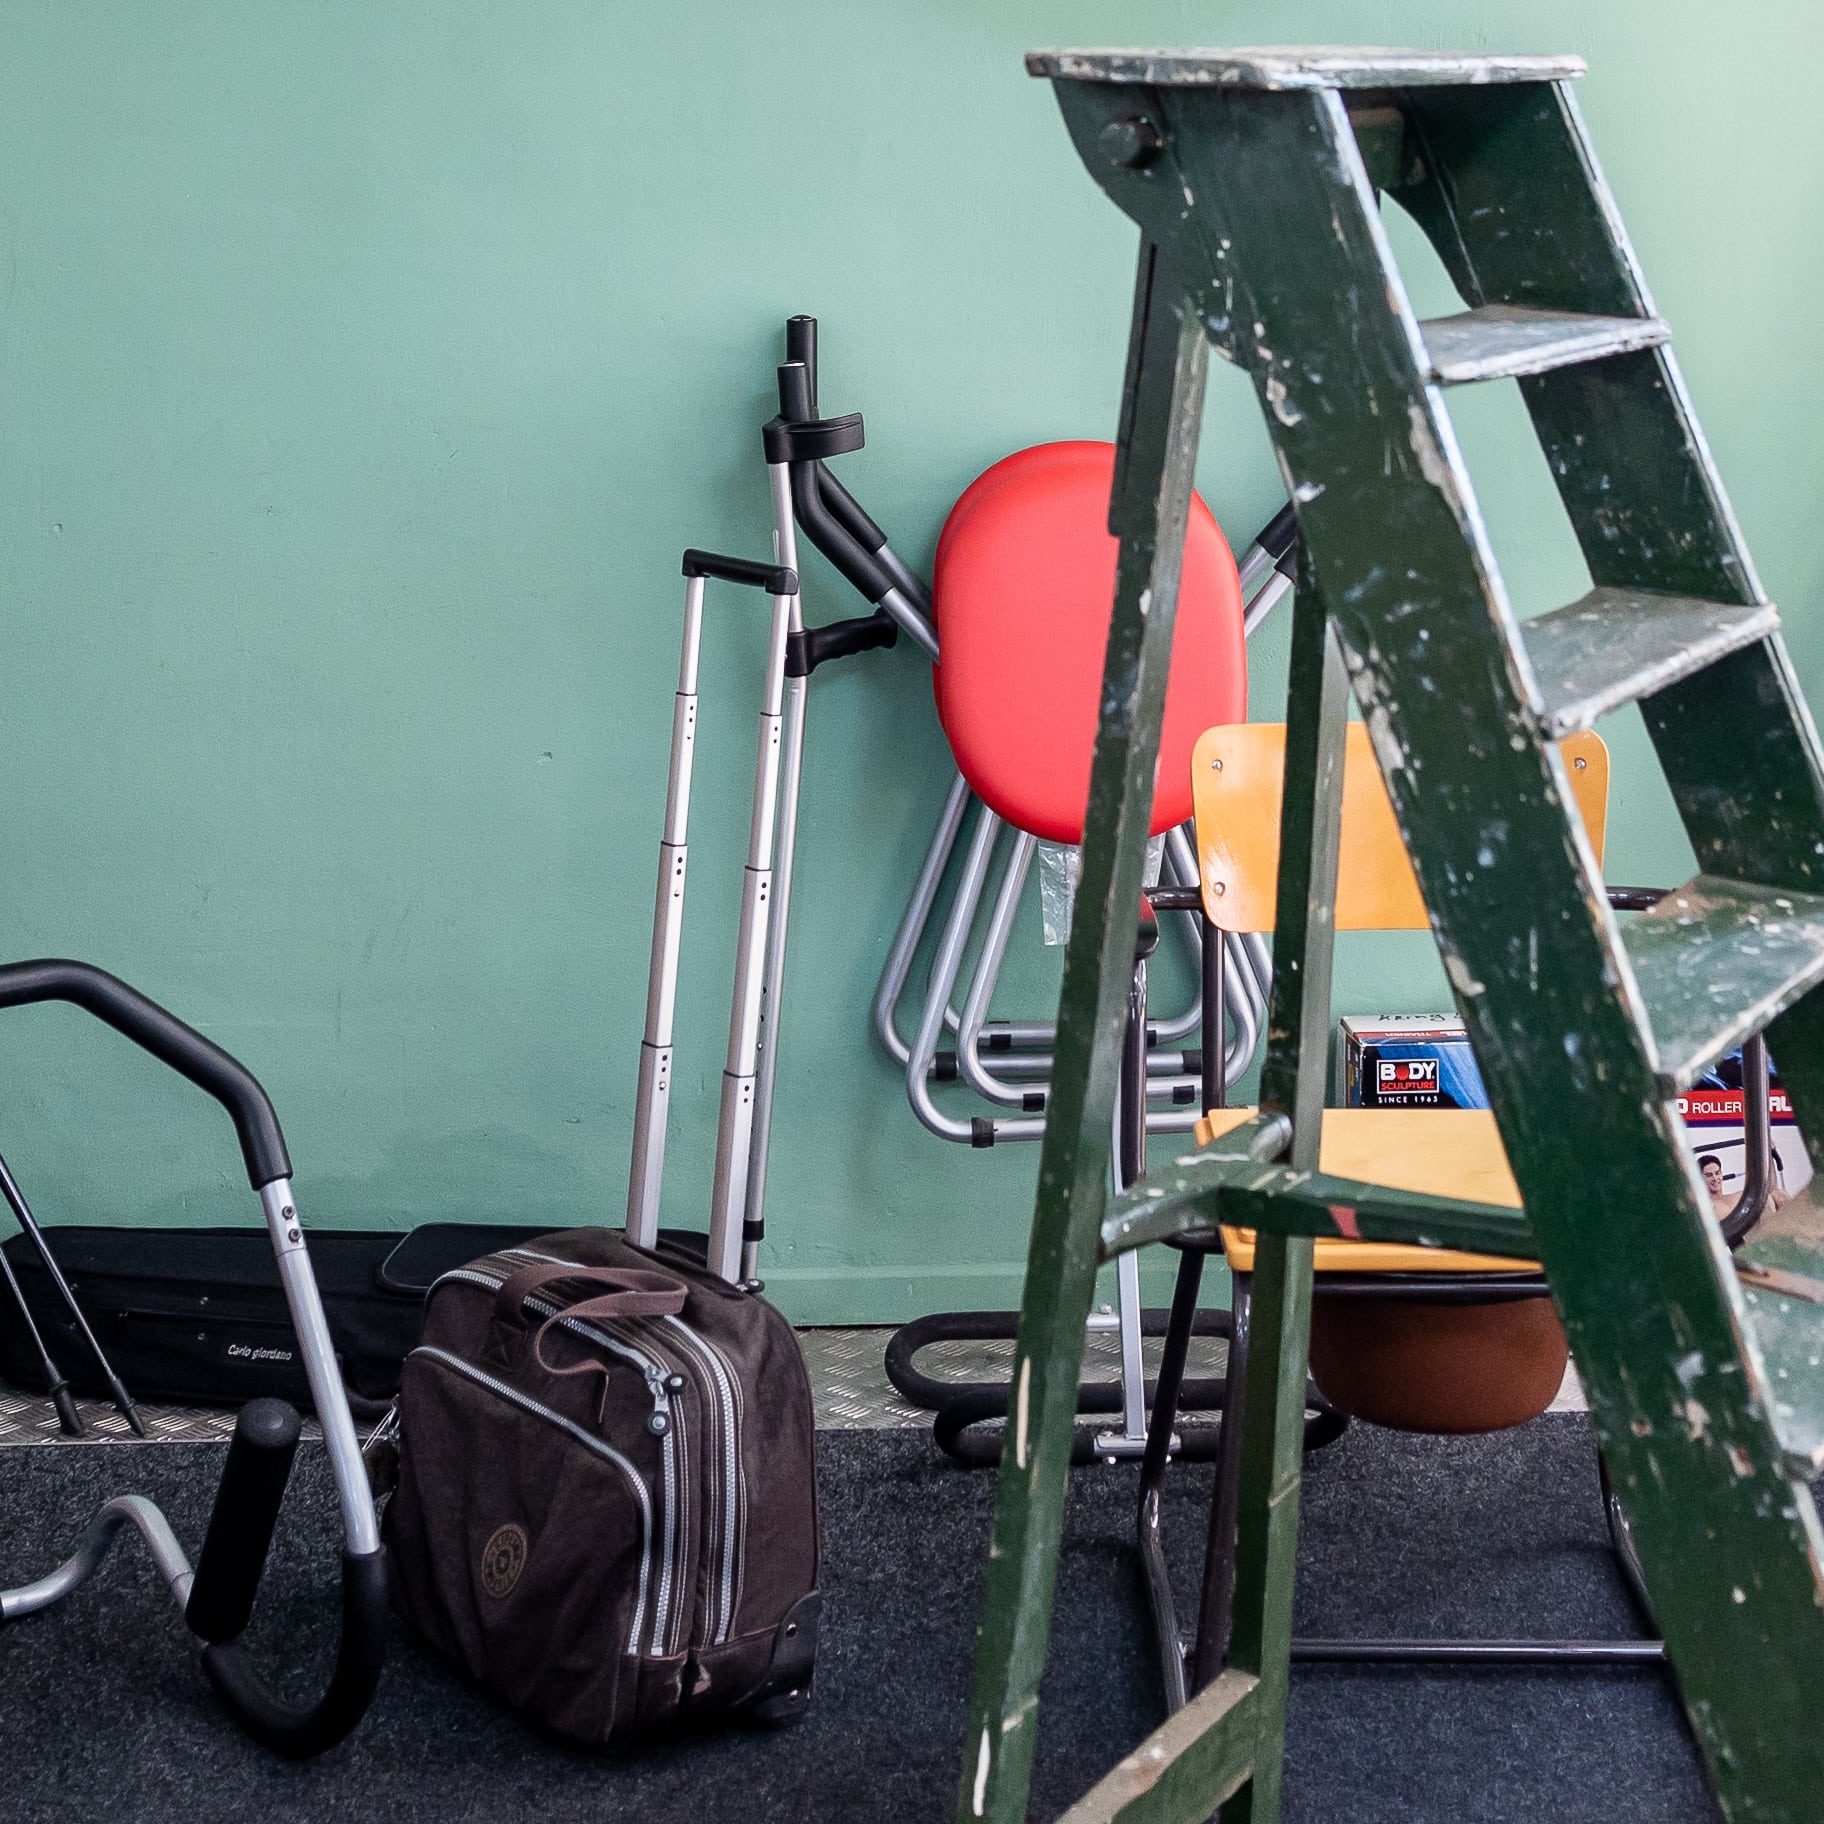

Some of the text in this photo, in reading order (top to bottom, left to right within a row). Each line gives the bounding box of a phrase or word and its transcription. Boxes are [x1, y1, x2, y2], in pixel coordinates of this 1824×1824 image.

[1380, 1062, 1436, 1080] BODY
[1381, 1081, 1435, 1091] SCULPTURE
[1378, 1096, 1408, 1104] SINCE
[1692, 1101, 1743, 1114] ROLLER
[228, 1344, 252, 1357] Carlo
